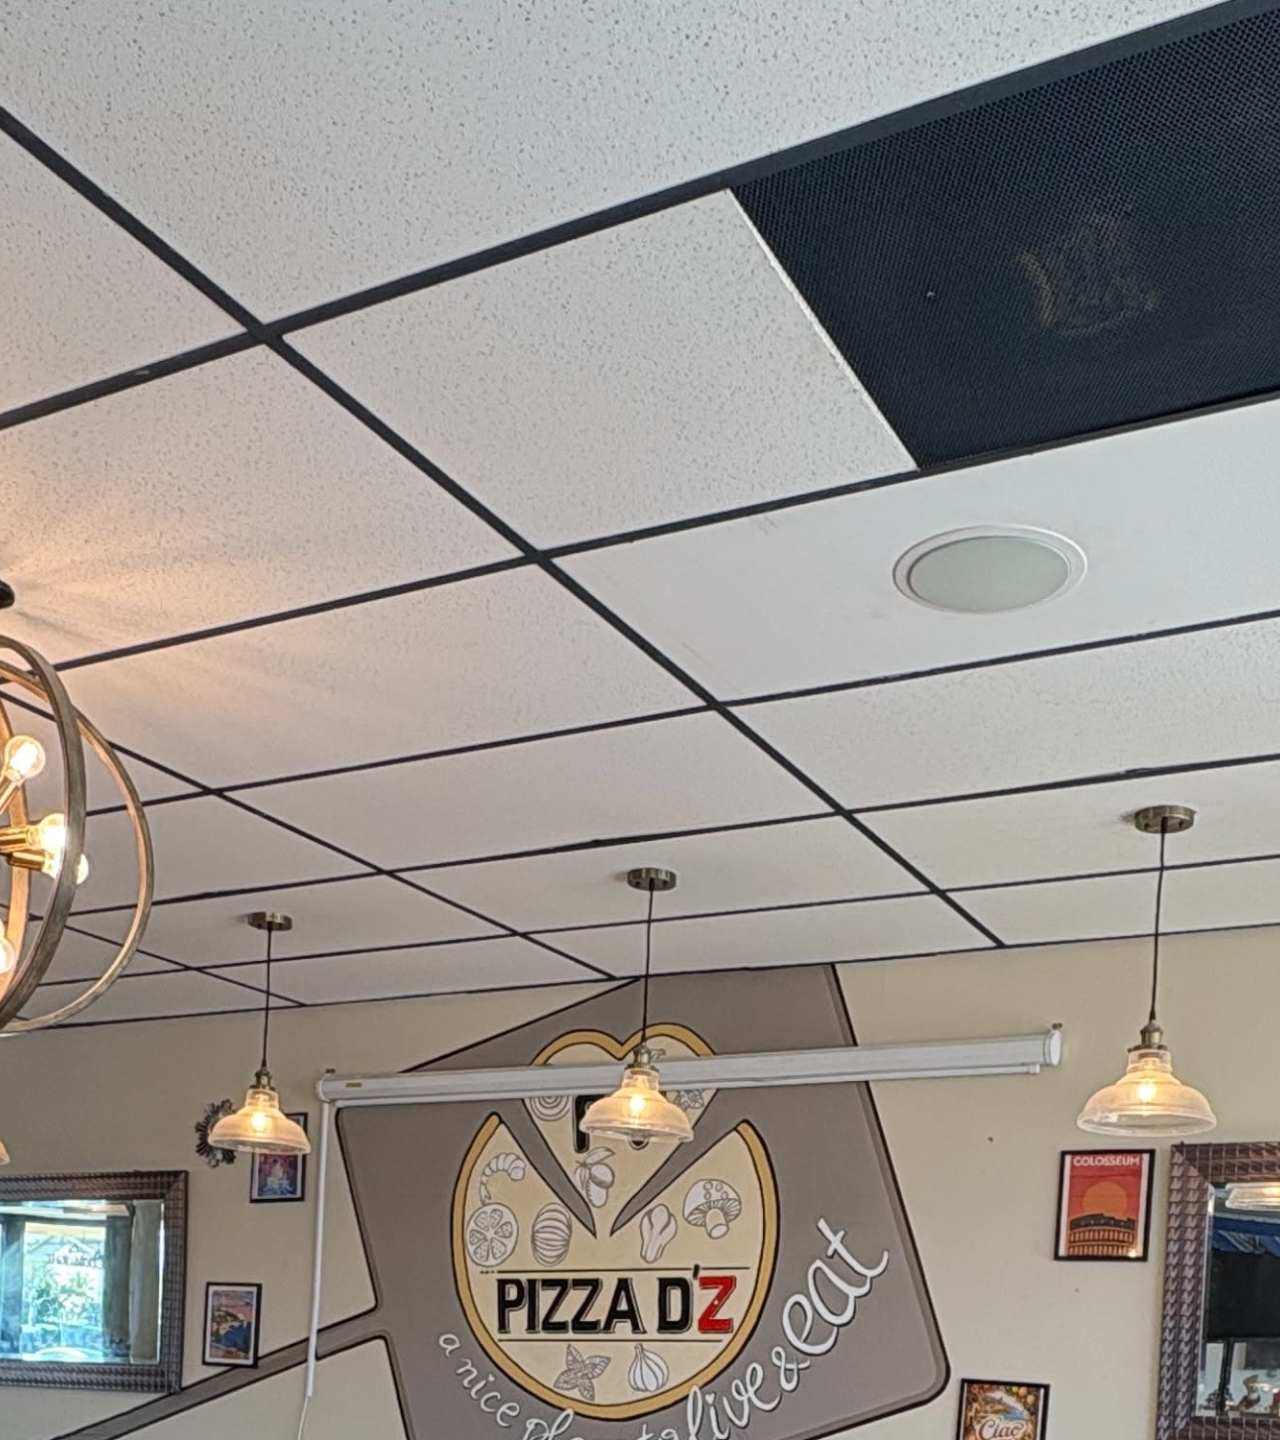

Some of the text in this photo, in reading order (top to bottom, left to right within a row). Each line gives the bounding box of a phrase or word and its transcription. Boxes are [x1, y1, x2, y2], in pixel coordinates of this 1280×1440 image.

[1072, 1155, 1140, 1167] COLOSSEUM
[496, 1264, 737, 1334] PIZZA D'Z
[782, 1218, 889, 1356] eat
[438, 1333, 462, 1357] a
[771, 1346, 811, 1392] &
[456, 1358, 520, 1427] nice
